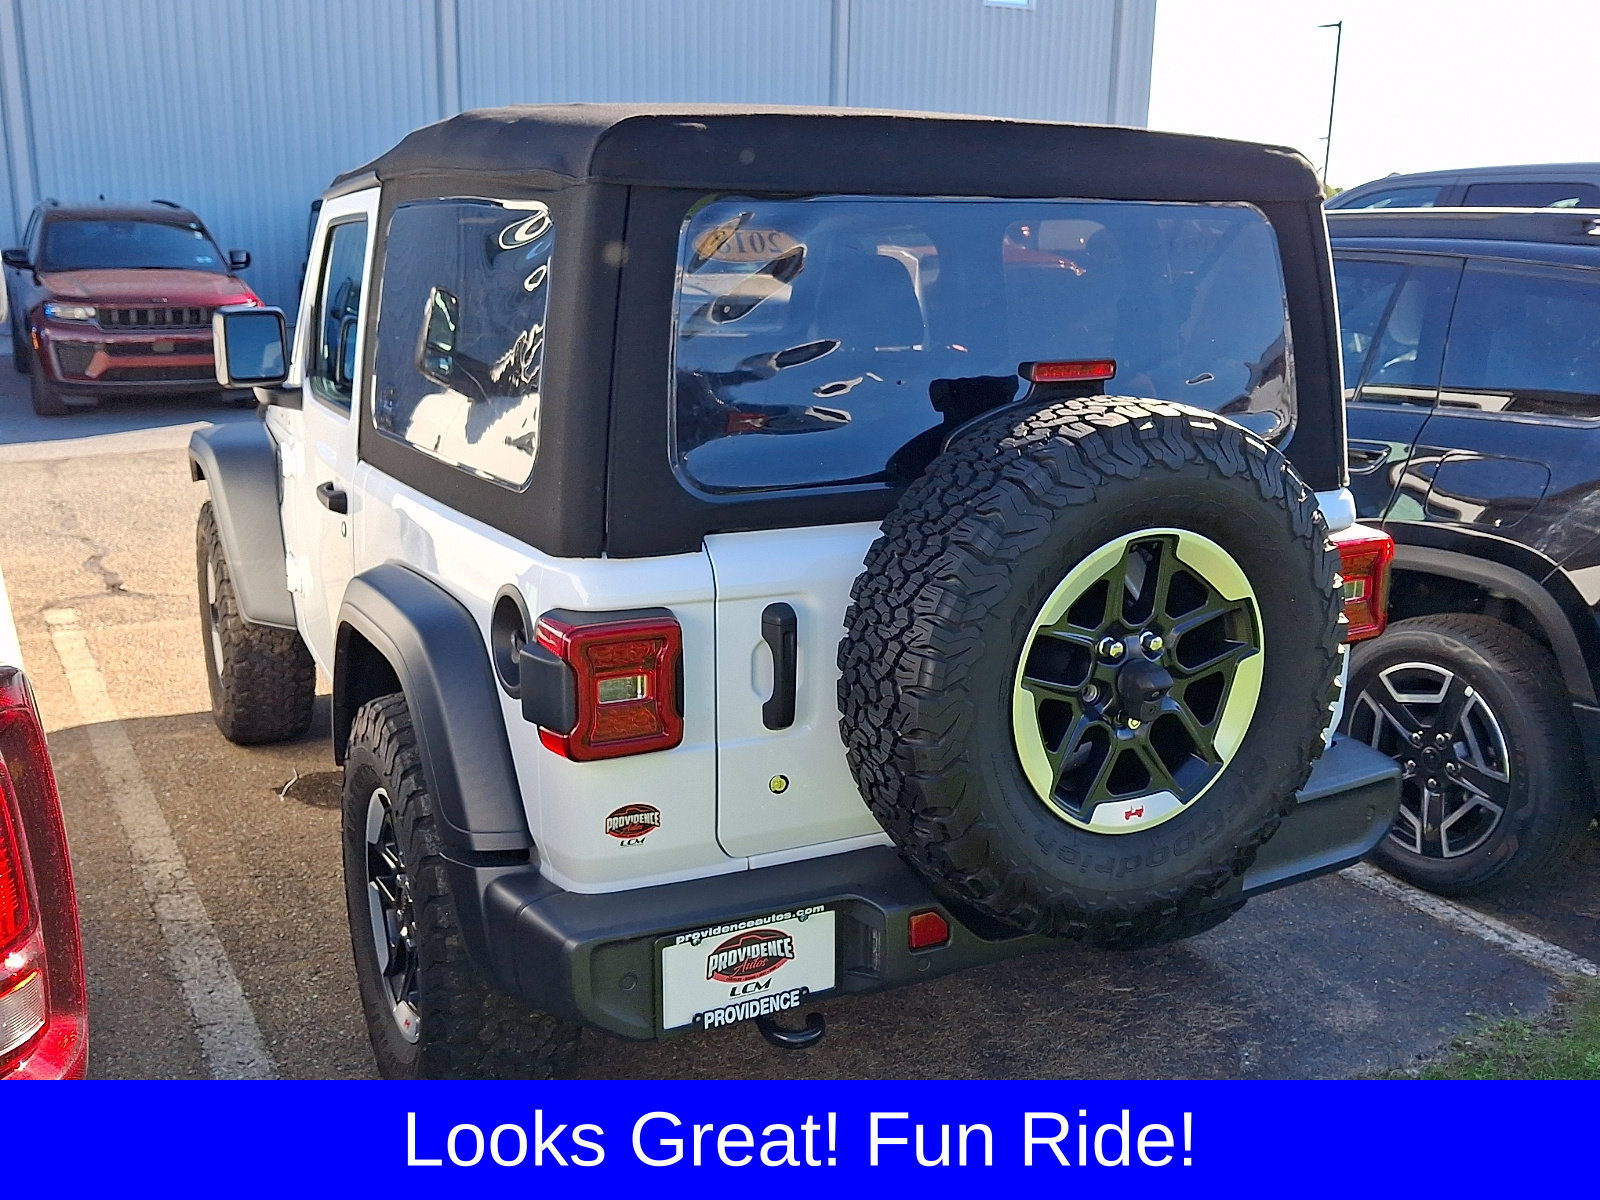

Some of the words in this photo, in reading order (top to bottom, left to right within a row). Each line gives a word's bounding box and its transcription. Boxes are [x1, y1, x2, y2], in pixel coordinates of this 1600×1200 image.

[606, 811, 660, 834] PROVIDENCE
[675, 904, 825, 945] providenceautos.com
[706, 937, 794, 979] PROVIDENCE
[733, 957, 768, 976] Autos
[730, 978, 772, 997] LCM
[703, 989, 800, 1030] PROVIDENCE
